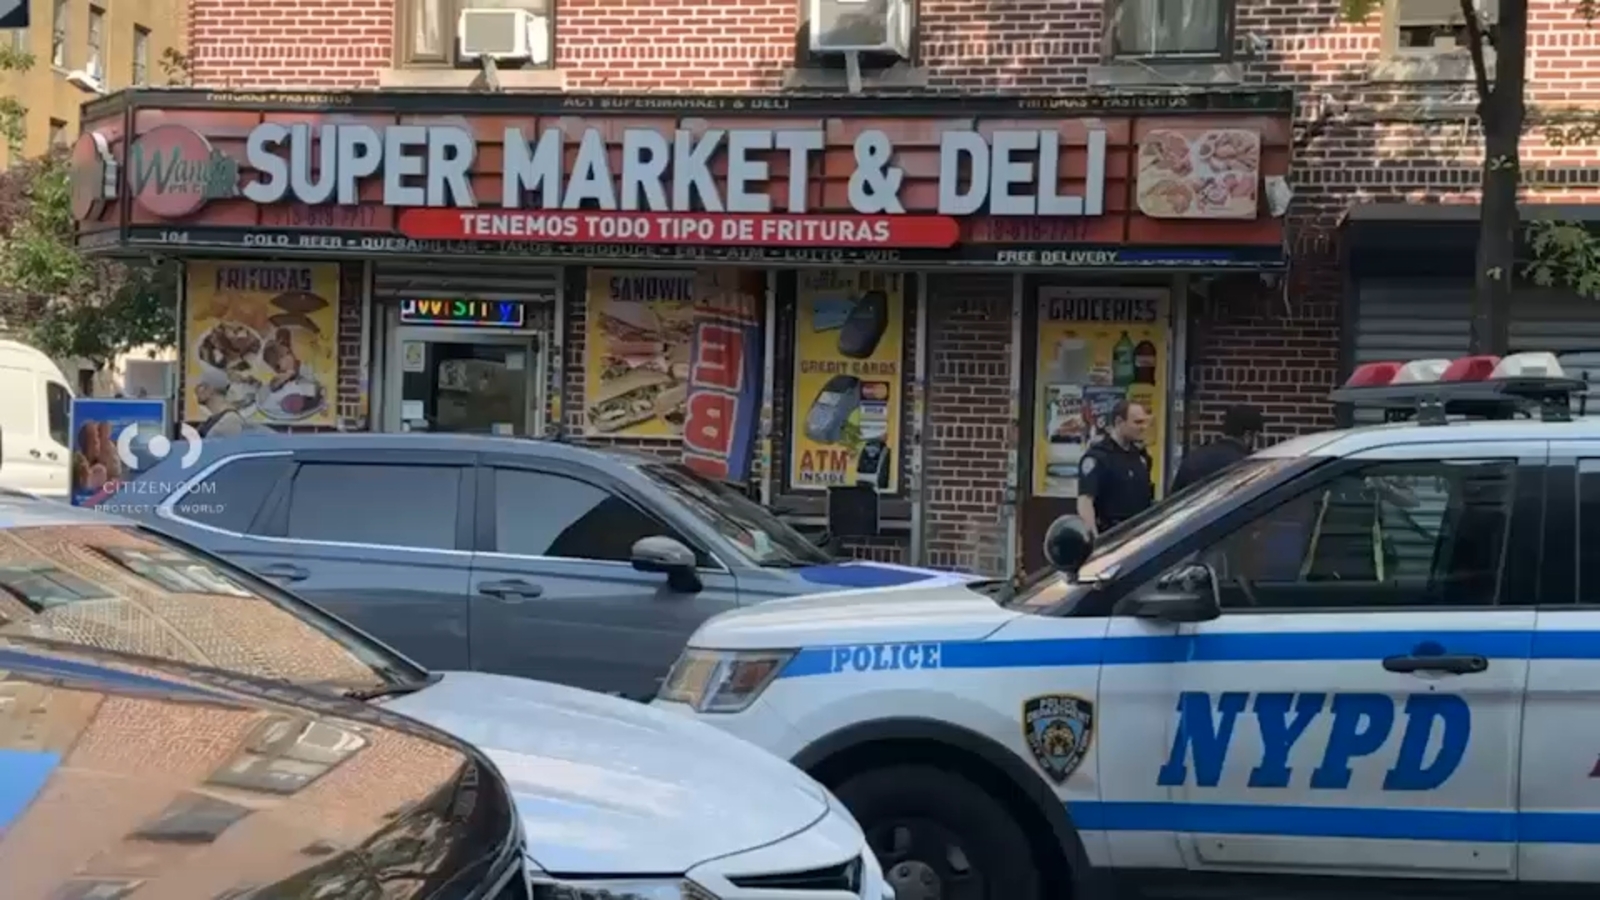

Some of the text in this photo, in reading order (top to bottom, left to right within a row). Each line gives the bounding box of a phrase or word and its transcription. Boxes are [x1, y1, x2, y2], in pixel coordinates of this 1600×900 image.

[243, 122, 1106, 215] SUPER MARKET & DELI
[460, 213, 890, 242] TENEMOS TODO TIPO DE FRITURAS
[243, 233, 289, 247] COLD
[299, 235, 342, 248] BEER
[361, 236, 478, 253] QUESADILLAS
[572, 244, 655, 257] PRODUCE
[997, 250, 1118, 264] FREE DELIVERY
[1050, 298, 1158, 321] GROCERIES
[800, 359, 898, 376] CREDIT CARDS
[799, 449, 849, 472] ATM
[799, 472, 847, 485] INSIDE
[832, 642, 939, 673] POLICE
[1157, 691, 1472, 791] NYPD
